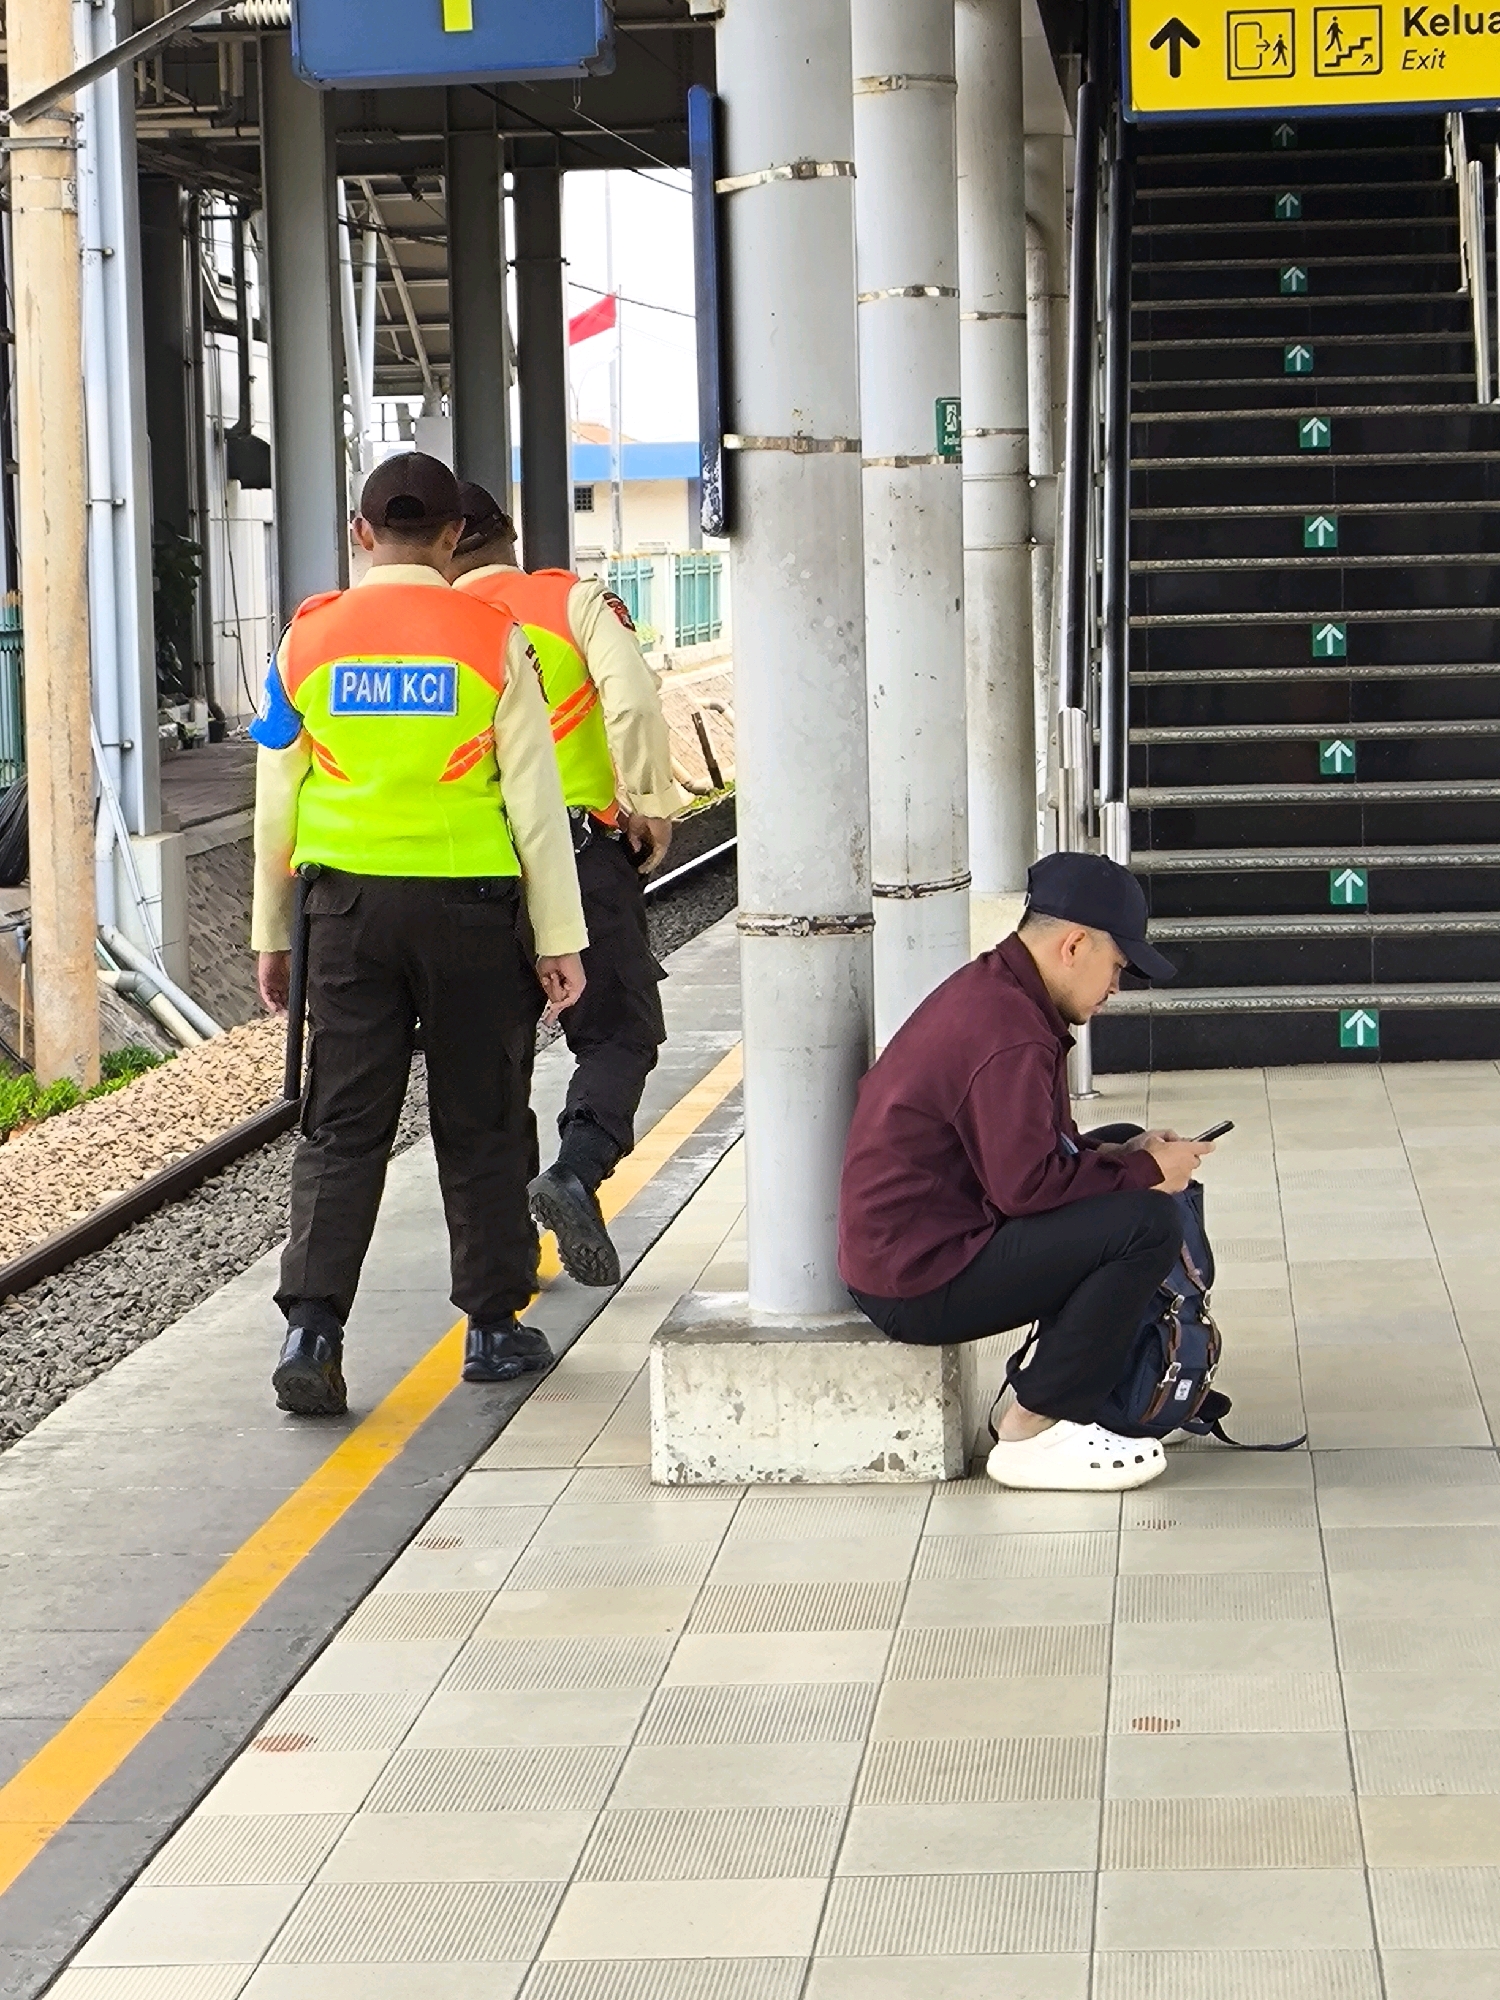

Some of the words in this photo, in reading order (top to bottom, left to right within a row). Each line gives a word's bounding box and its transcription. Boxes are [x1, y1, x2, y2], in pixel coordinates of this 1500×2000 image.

[1401, 47, 1446, 70] Exit
[342, 671, 392, 703] PAM
[403, 672, 446, 704] KCI
